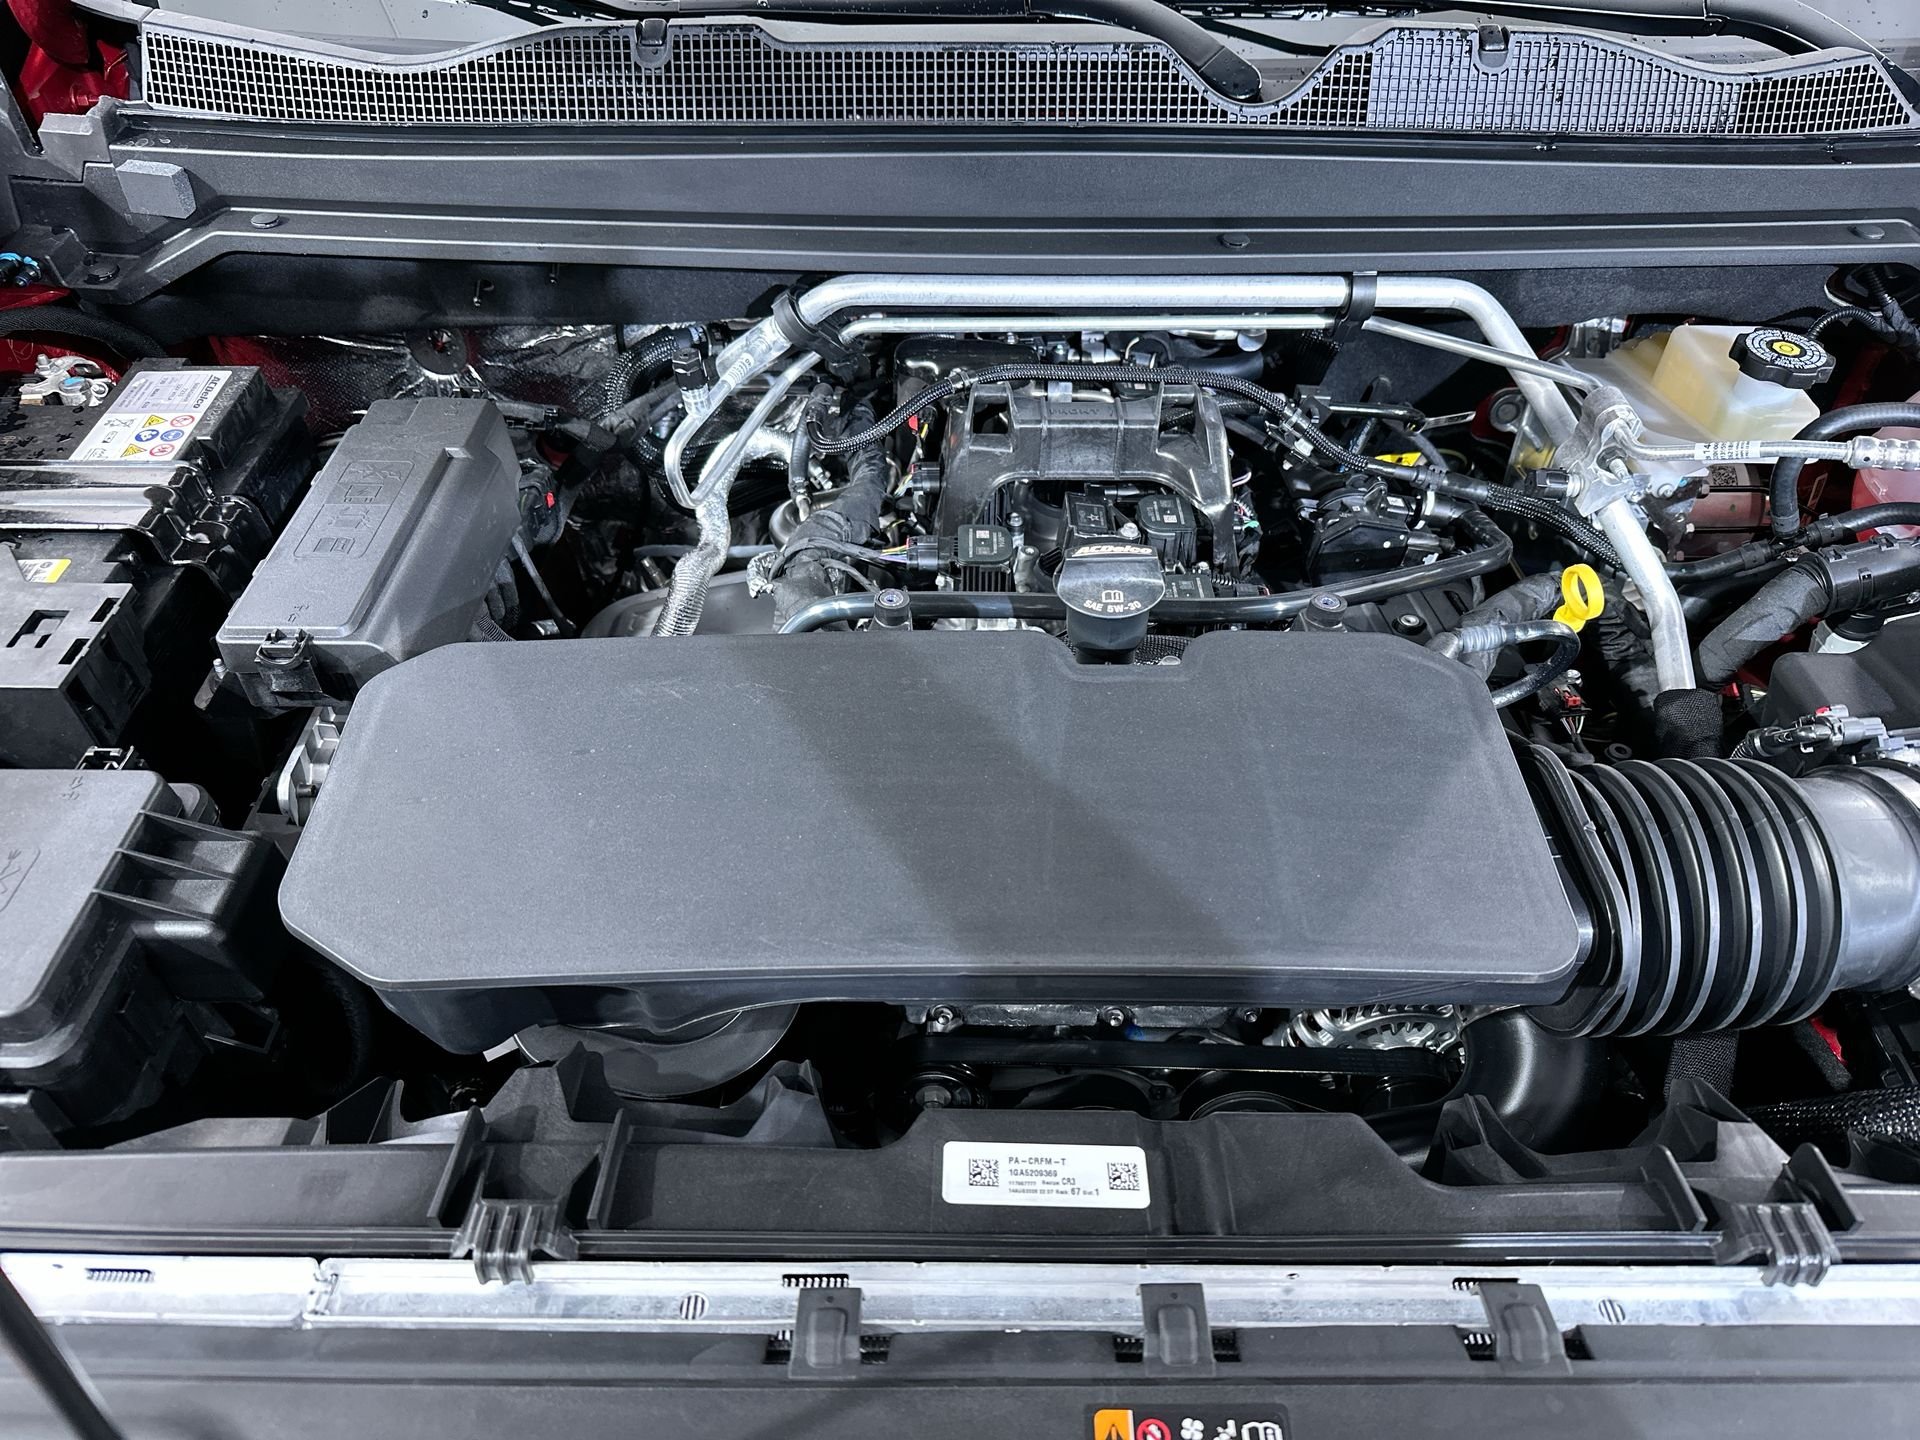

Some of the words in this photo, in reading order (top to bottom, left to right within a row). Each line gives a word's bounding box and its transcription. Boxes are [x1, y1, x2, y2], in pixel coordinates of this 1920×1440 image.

[193, 376, 221, 409] ACDelco
[1074, 545, 1153, 554] ACDelco
[1083, 599, 1104, 611] SAE
[1107, 600, 1142, 613] 5W-30
[1061, 1177, 1076, 1186] CR3
[1070, 1187, 1081, 1196] 67
[1095, 1188, 1099, 1196] 1
